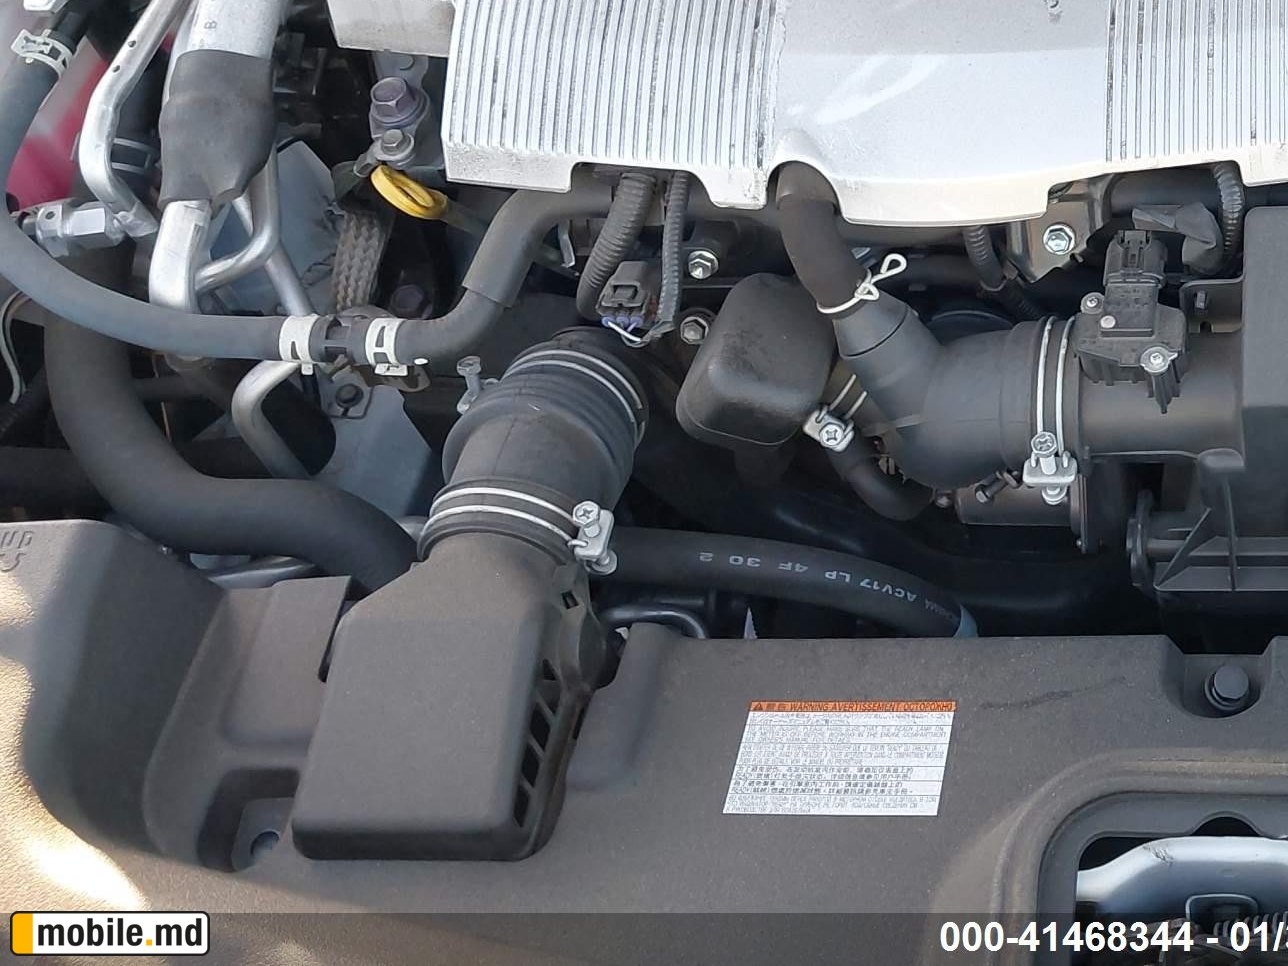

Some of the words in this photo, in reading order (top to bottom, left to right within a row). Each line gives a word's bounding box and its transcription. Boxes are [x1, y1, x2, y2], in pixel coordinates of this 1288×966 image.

[778, 561, 808, 573] 4F
[825, 570, 851, 583] LP
[860, 579, 917, 602] ACV17
[790, 703, 828, 711] WARNING
[832, 702, 899, 711] AVERTISSEMENT
